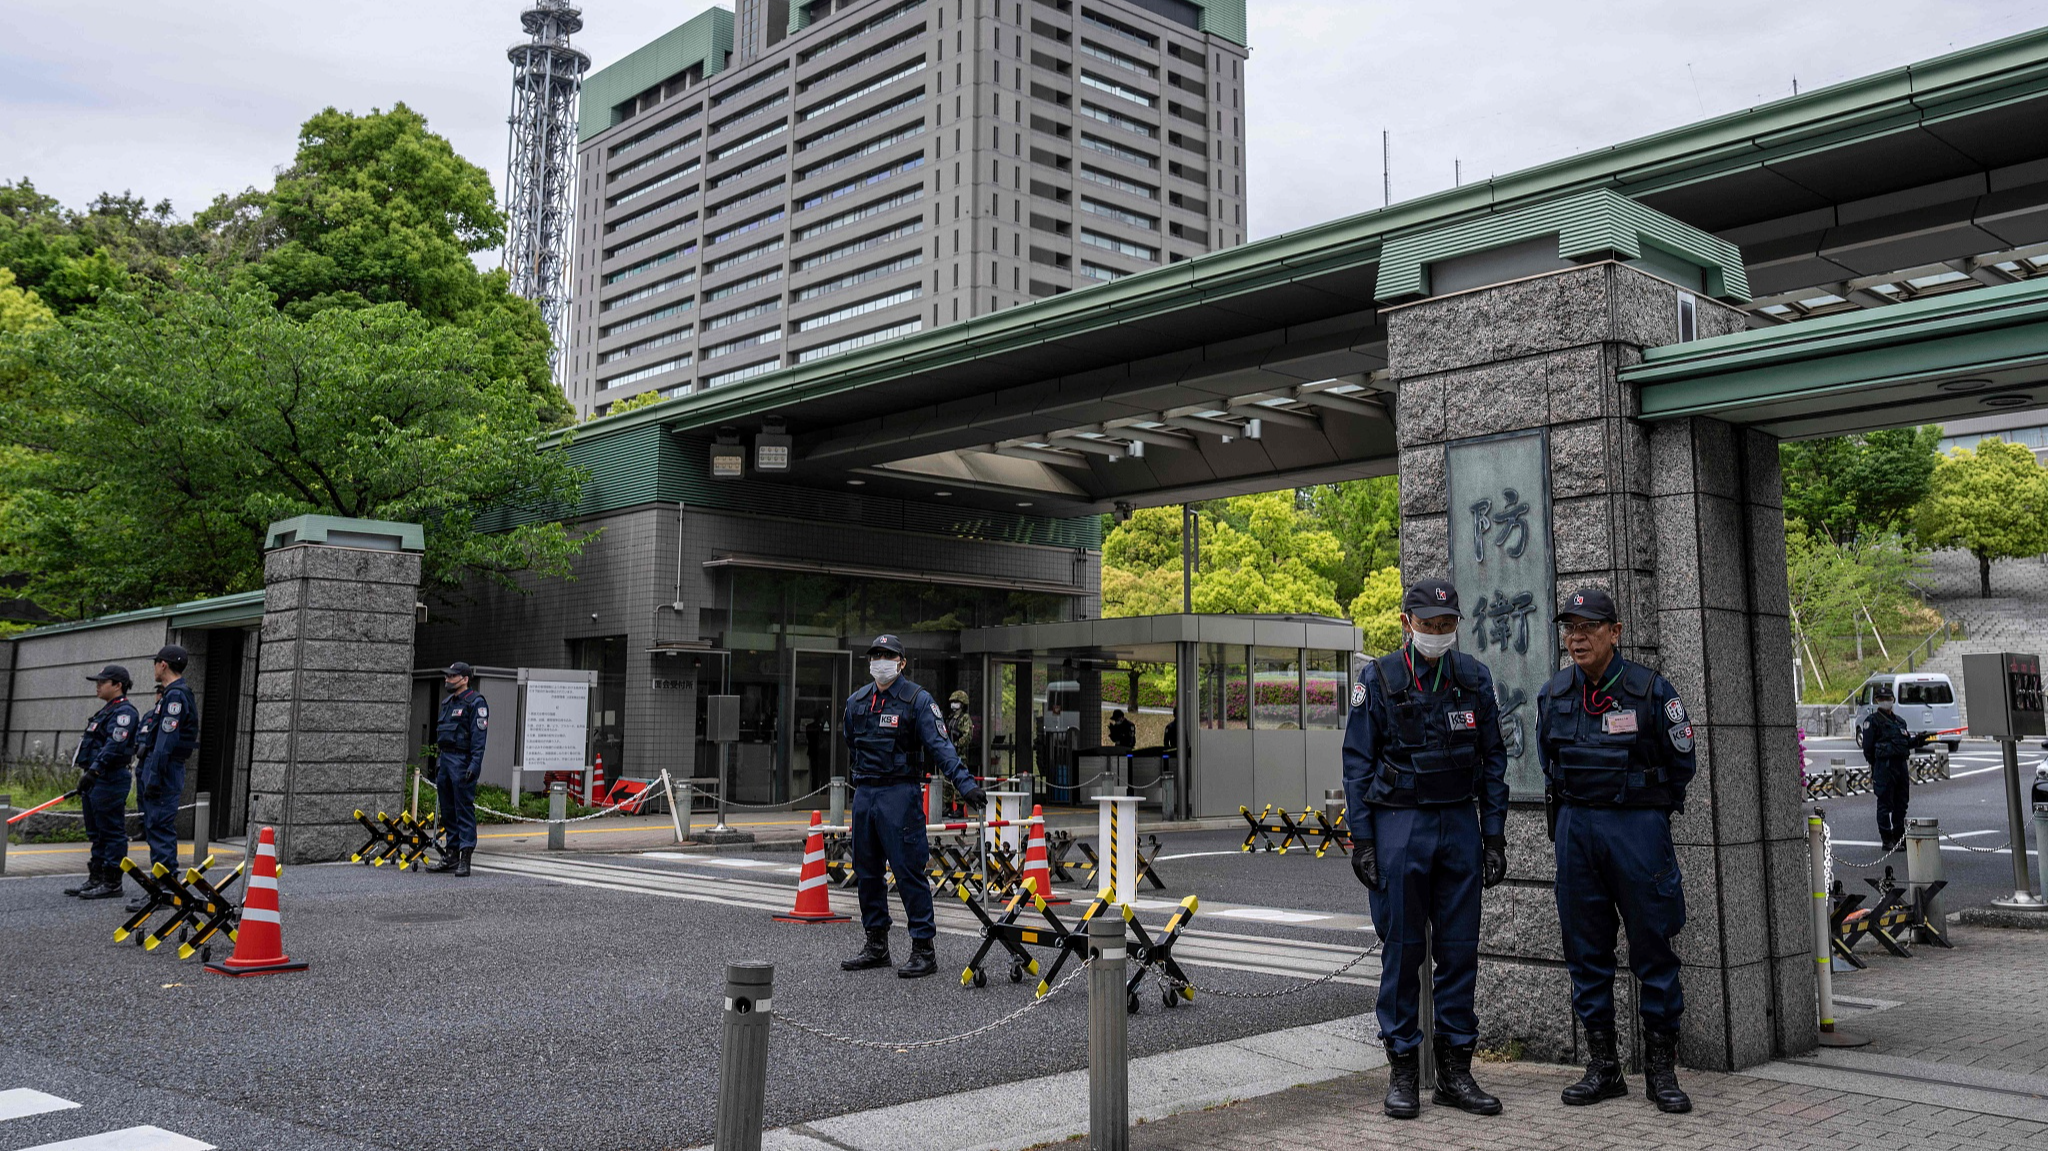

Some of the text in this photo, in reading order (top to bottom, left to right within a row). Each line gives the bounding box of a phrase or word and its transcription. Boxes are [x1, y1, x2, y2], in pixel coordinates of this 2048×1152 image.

[881, 715, 898, 724] KSS
[1451, 713, 1474, 725] KSS
[1673, 727, 1692, 741] KSS
